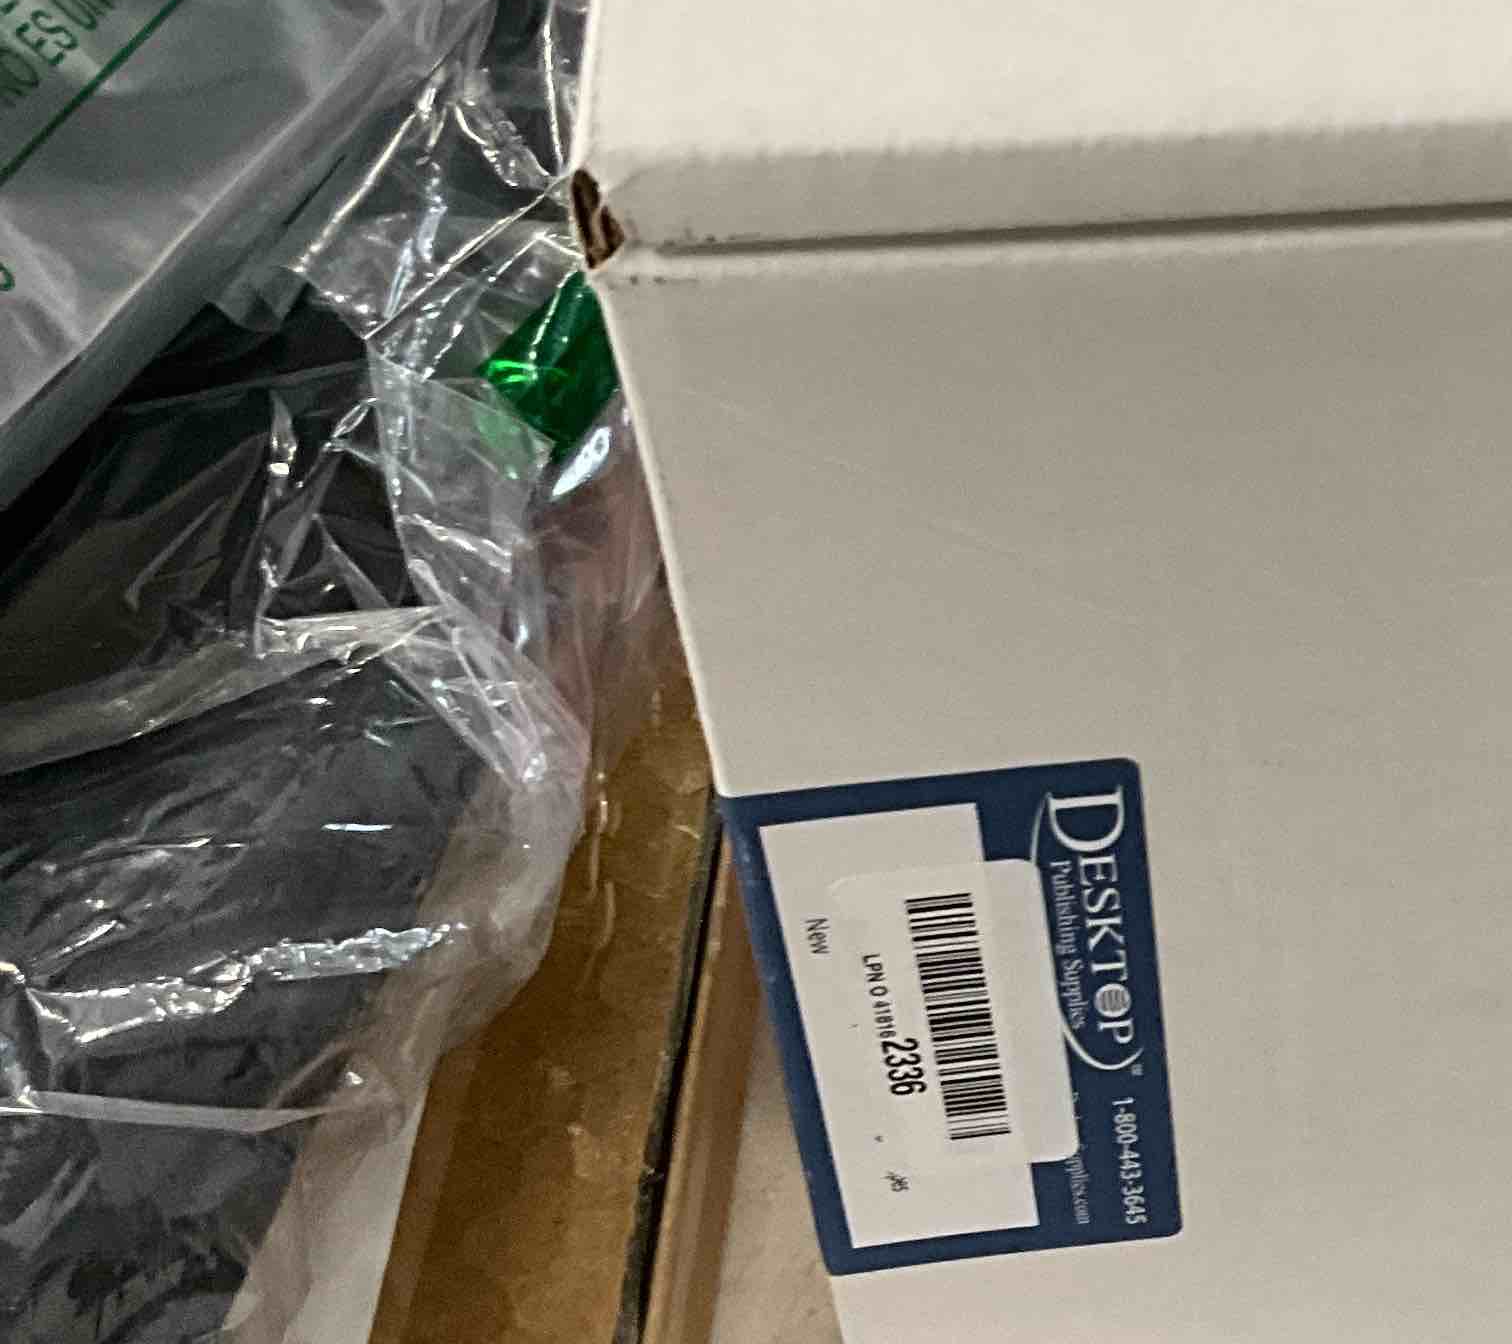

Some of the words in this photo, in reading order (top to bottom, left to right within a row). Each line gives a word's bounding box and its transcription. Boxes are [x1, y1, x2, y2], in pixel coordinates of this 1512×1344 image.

[804, 917, 831, 956] New
[1048, 785, 1136, 1046] DESKTOP
[1050, 858, 1081, 955] Publishing
[862, 952, 887, 983] LPN
[1111, 1096, 1149, 1226] 1-800-443-3645
